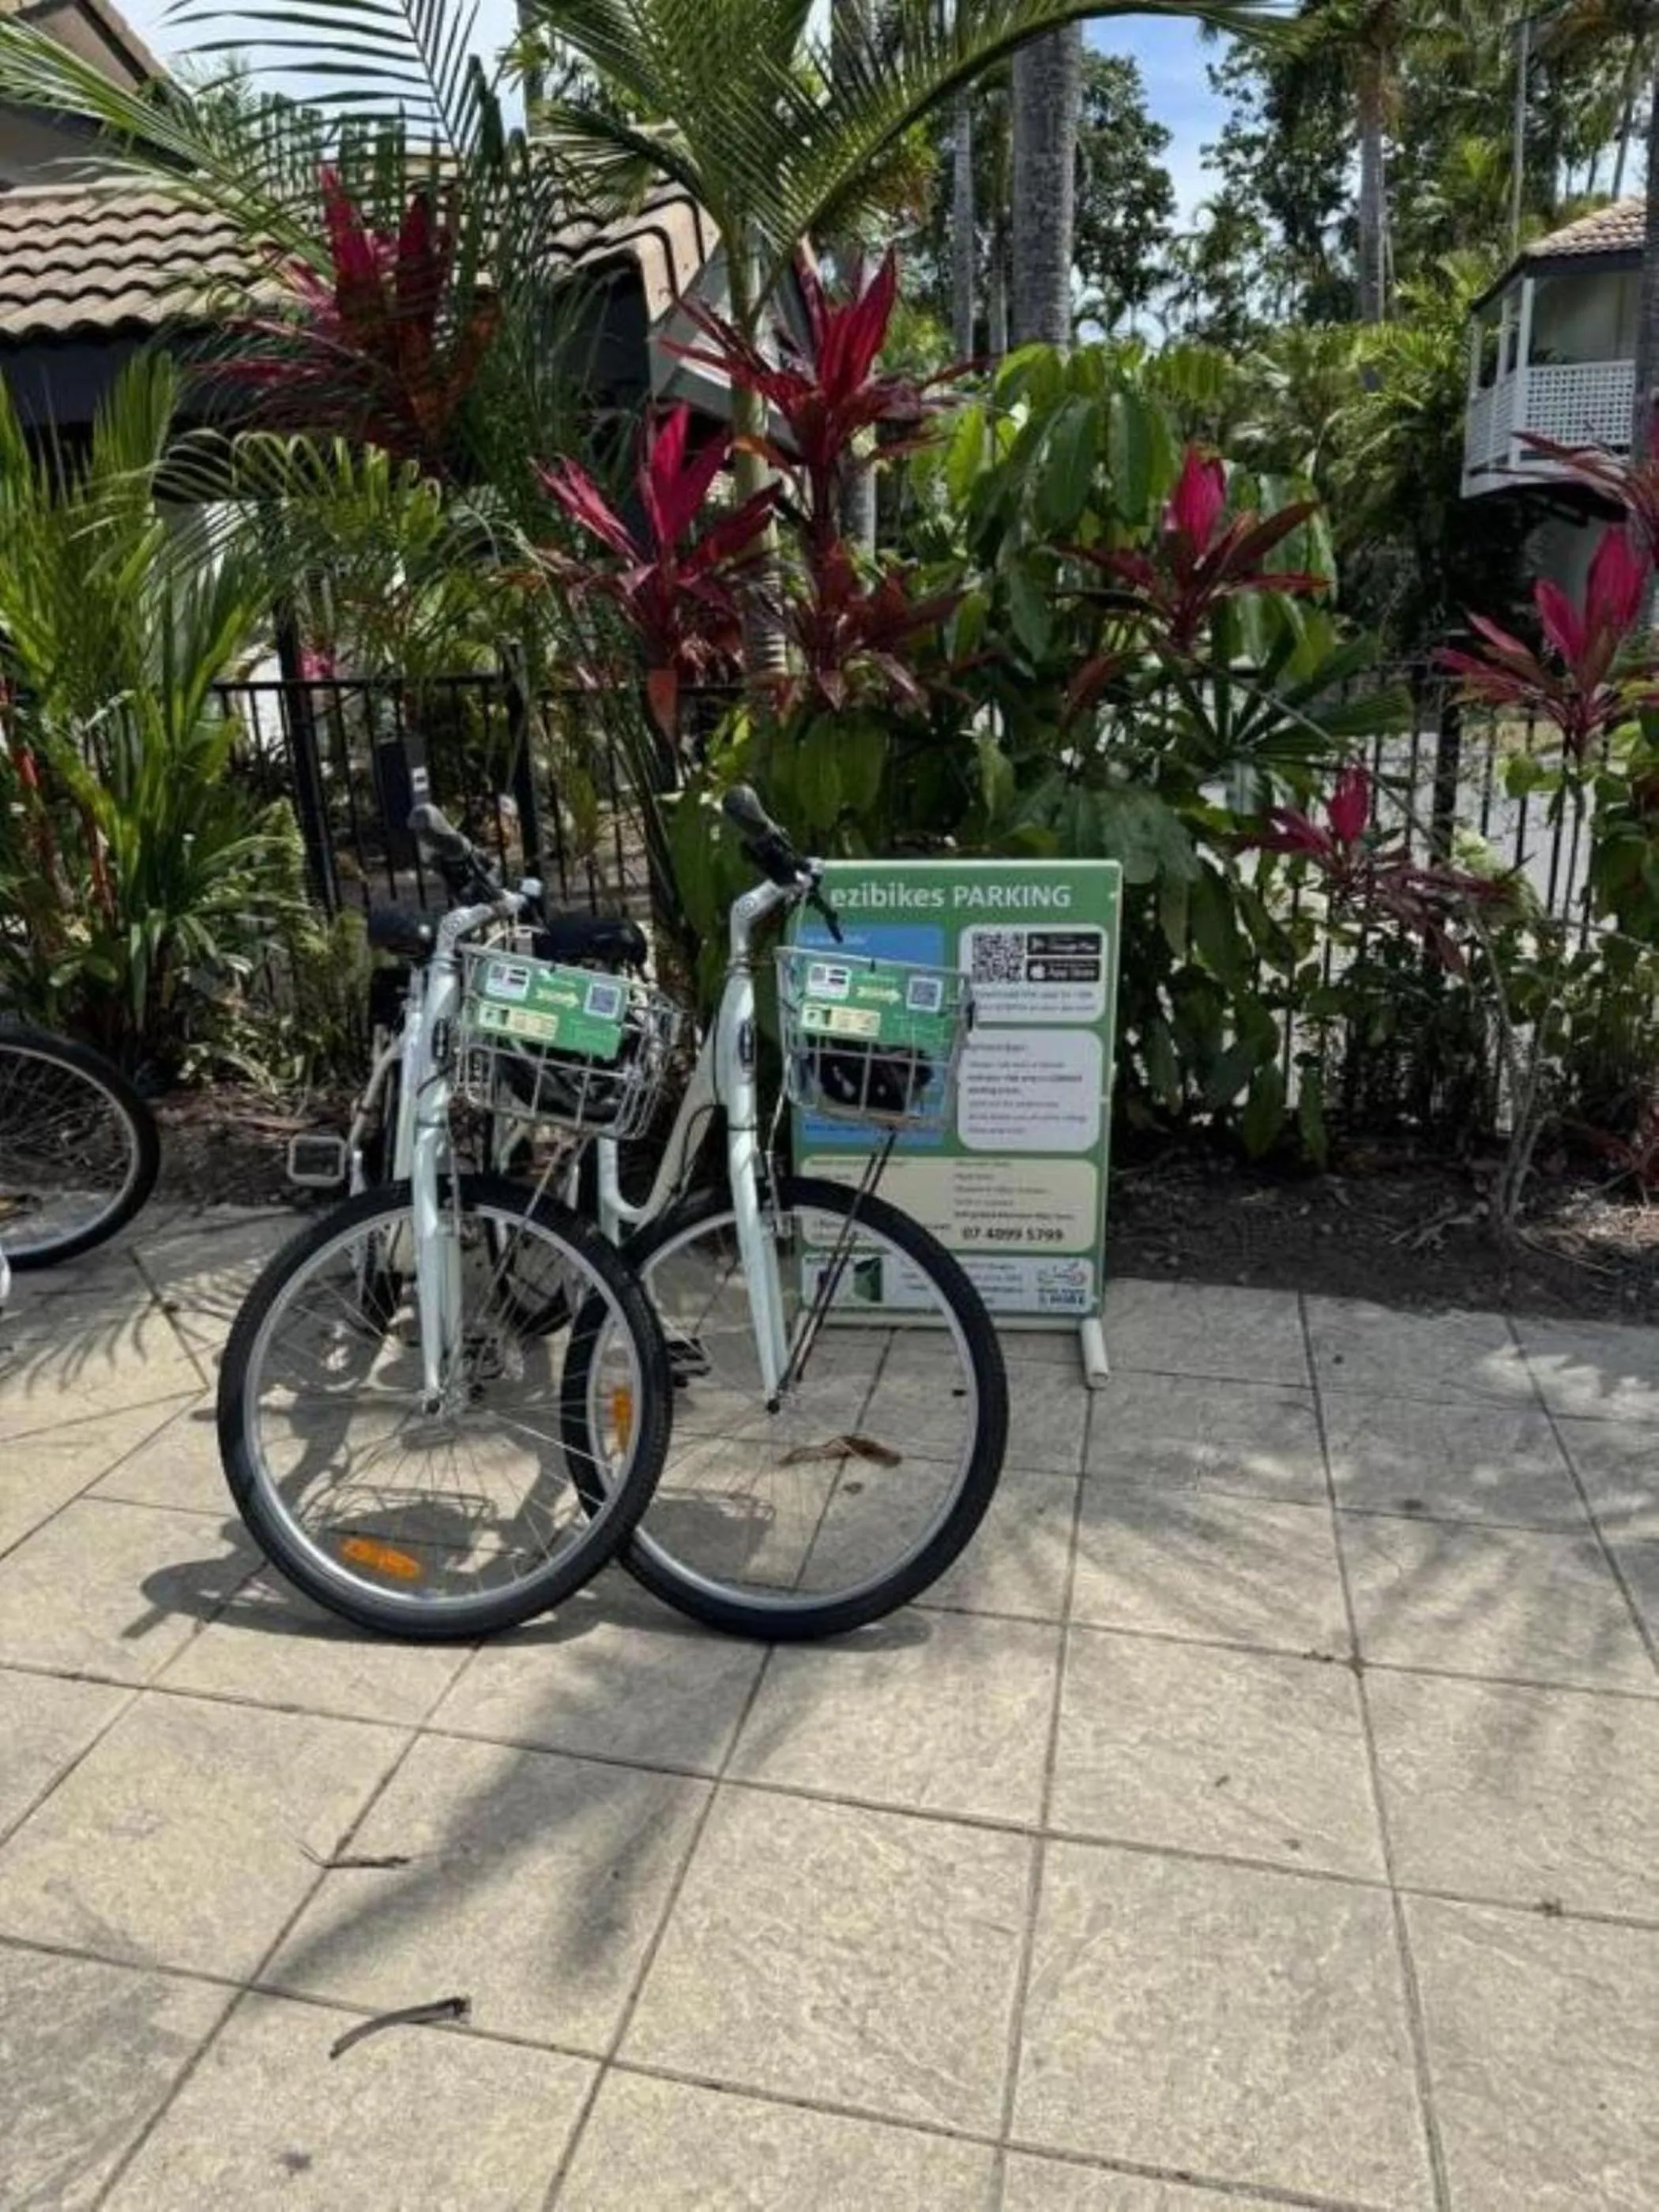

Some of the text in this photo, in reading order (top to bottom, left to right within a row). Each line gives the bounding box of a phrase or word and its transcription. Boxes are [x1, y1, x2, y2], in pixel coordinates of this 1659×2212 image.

[830, 882, 1072, 908] ezibikes PARKING
[961, 1226, 981, 1241] 07
